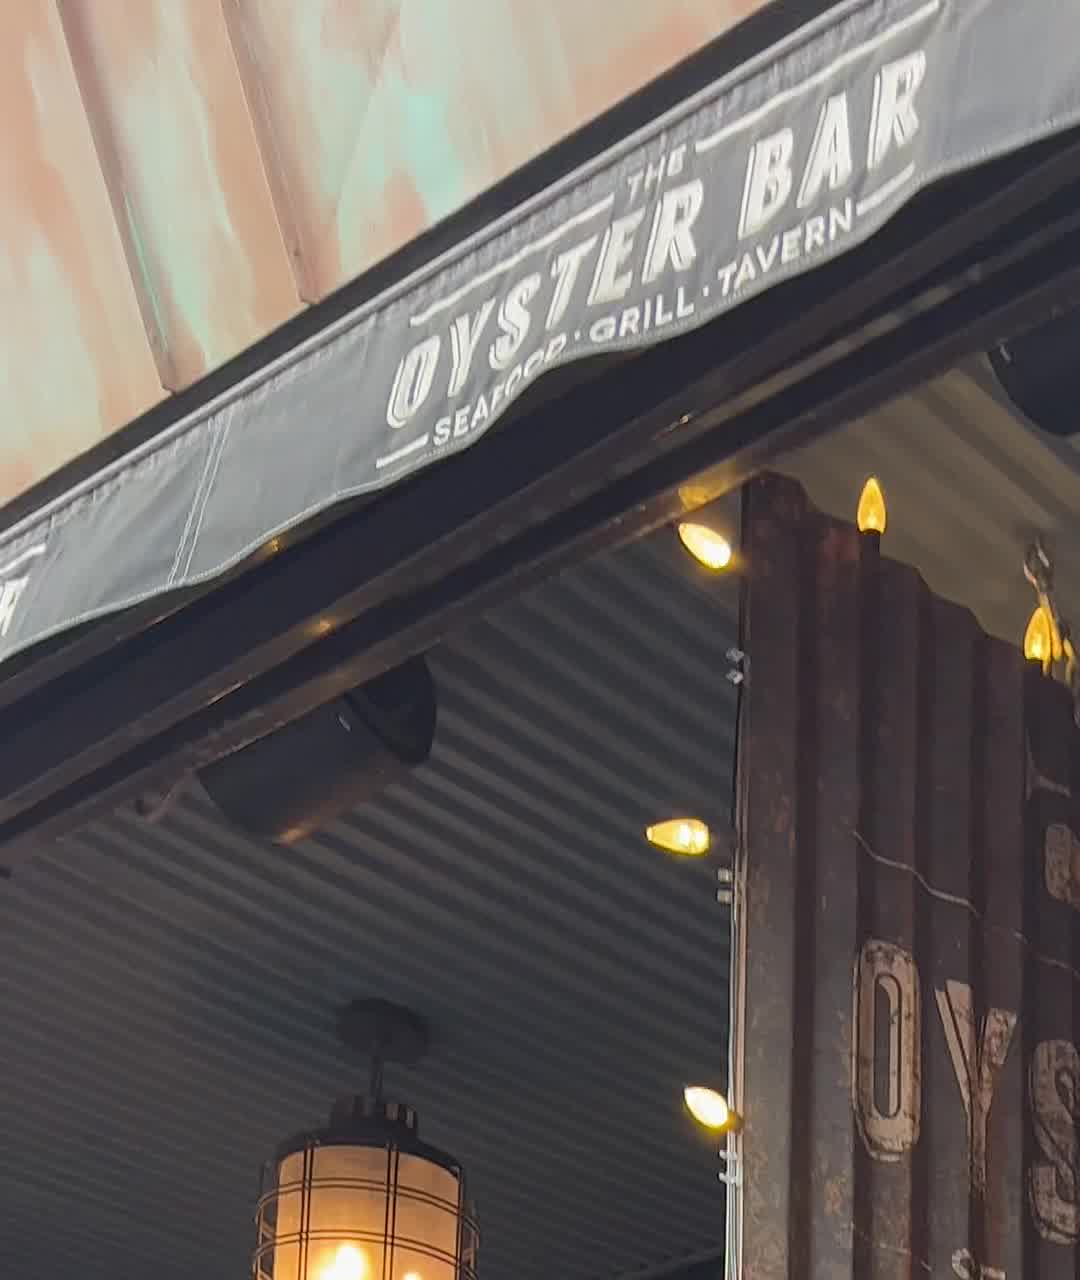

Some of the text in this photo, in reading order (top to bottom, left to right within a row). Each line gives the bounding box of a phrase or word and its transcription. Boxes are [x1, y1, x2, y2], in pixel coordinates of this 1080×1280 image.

[386, 49, 927, 429] OYSTER BAR
[627, 143, 687, 202] THE
[432, 196, 853, 447] SEAFOOD GRILL TAVERN
